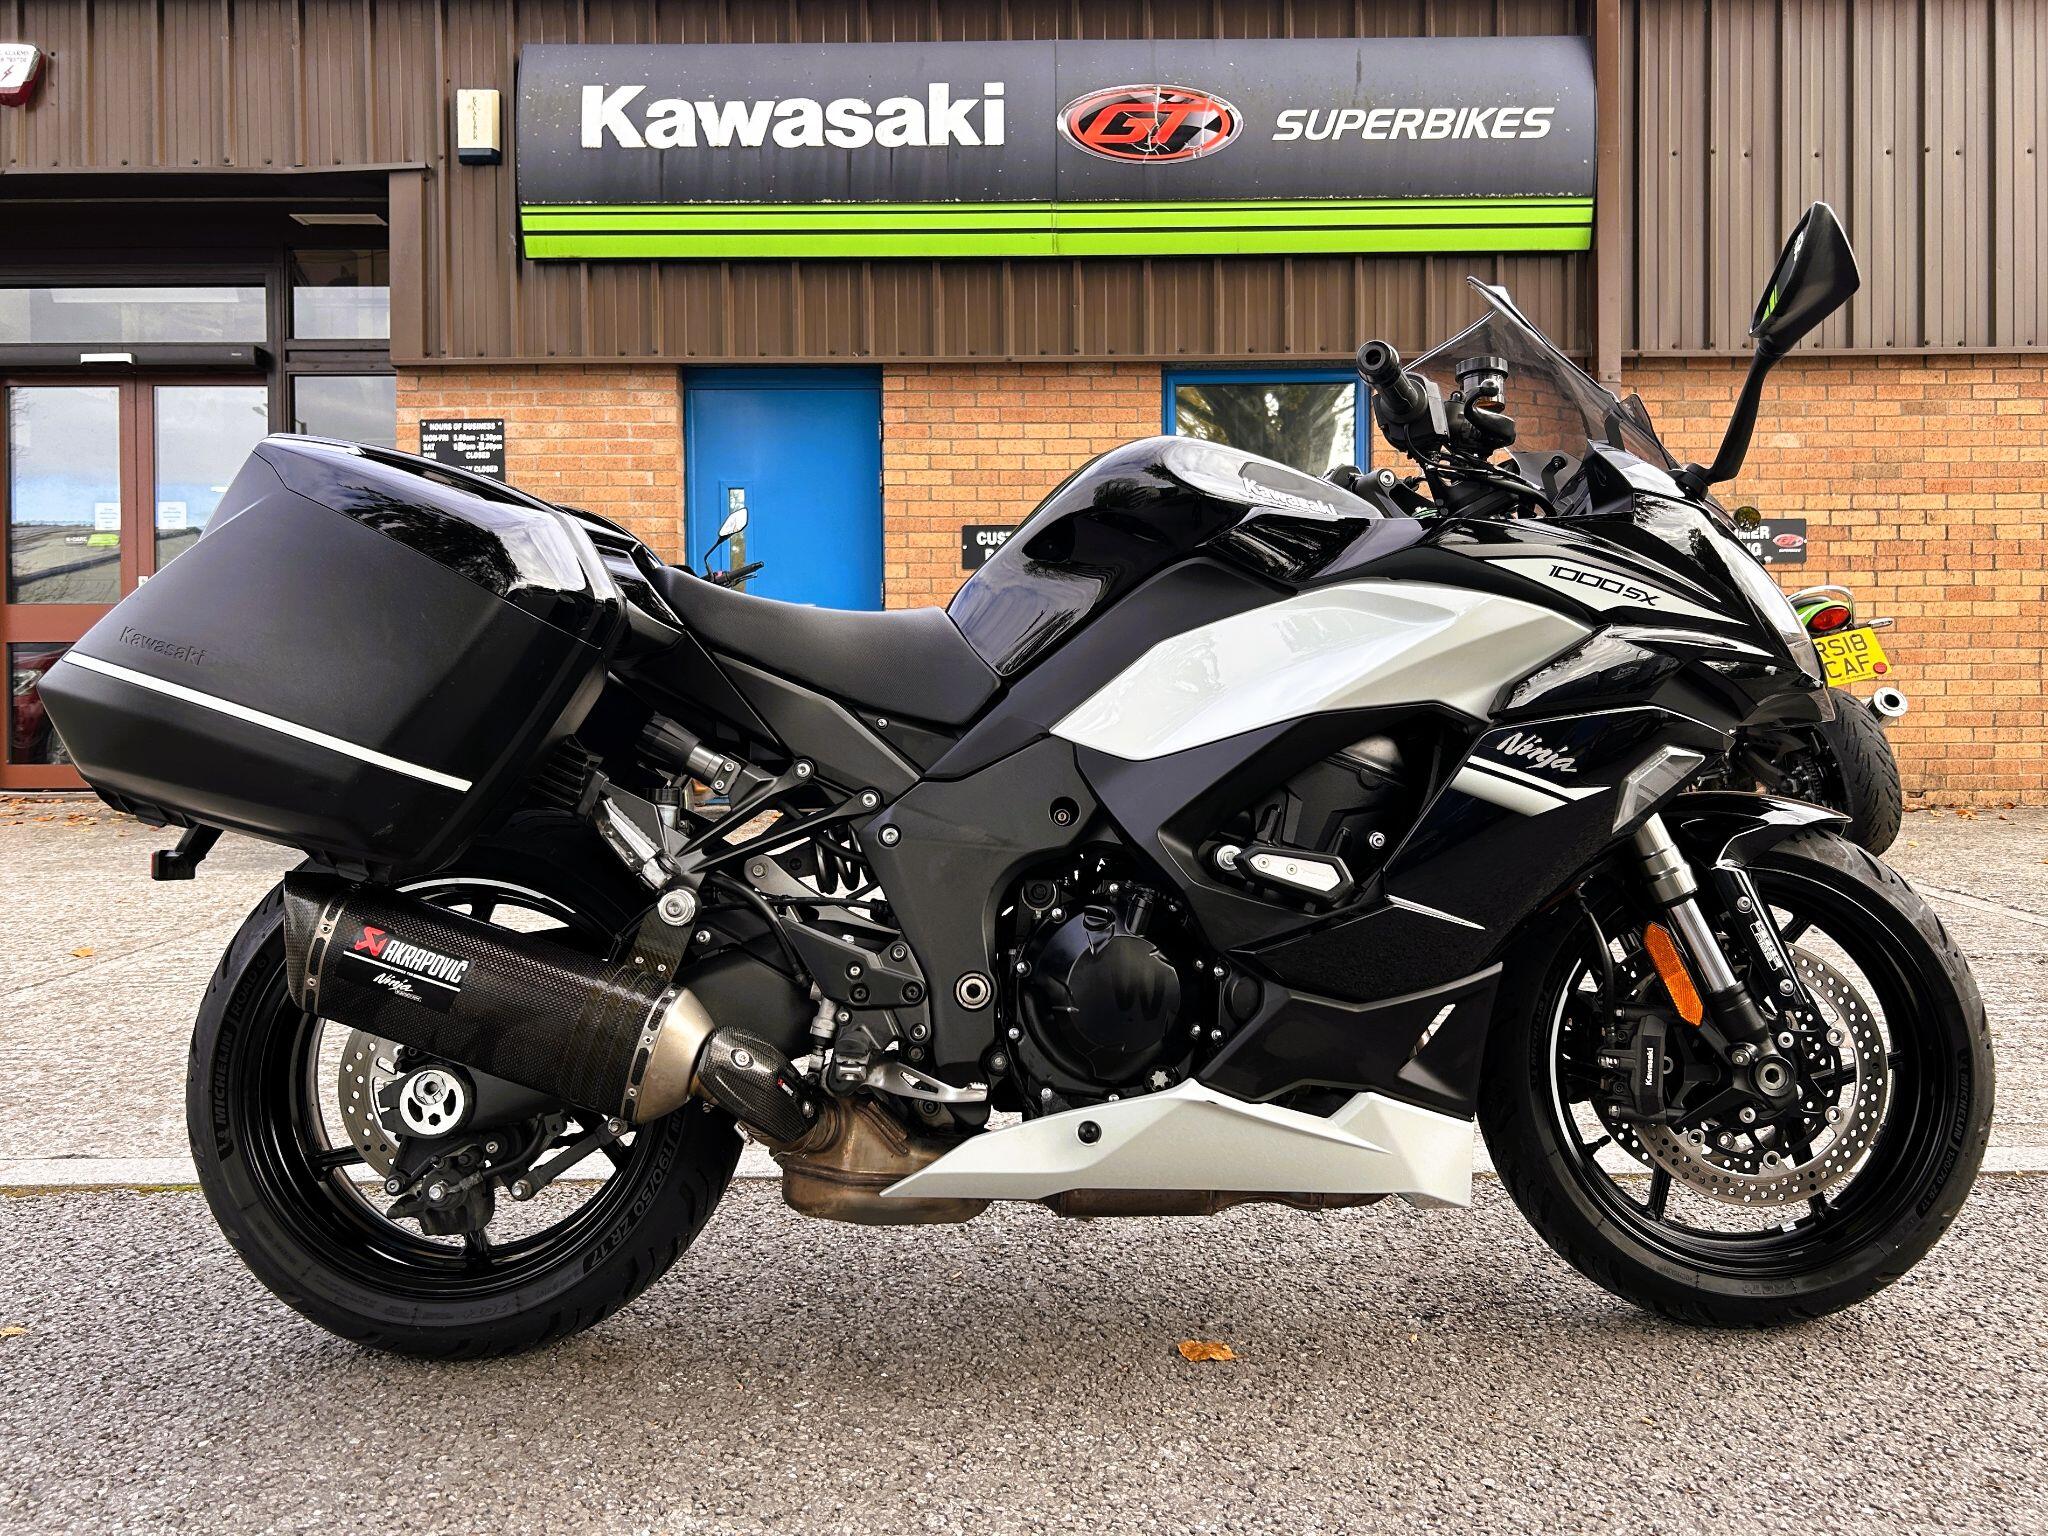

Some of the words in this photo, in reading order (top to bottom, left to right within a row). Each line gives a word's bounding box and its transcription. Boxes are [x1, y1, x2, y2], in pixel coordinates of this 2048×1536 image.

[581, 82, 1005, 150] Kawasaki
[1272, 106, 1555, 141] SUPERBIKES
[429, 422, 453, 431] HOURS
[453, 422, 462, 431] OF
[462, 422, 496, 431] BUSINESS
[422, 443, 436, 451] SAT
[465, 451, 491, 460] CLOSED
[473, 465, 499, 473] CLOSED
[1242, 477, 1338, 516] Kawasaki
[119, 626, 207, 666] Kawasaki
[1815, 633, 1868, 658] RS18
[1824, 652, 1870, 678] CAF
[1496, 732, 1577, 773] Ninja
[373, 972, 414, 992] Ninja
[214, 1030, 234, 1125] MICHELIN
[231, 968, 257, 1017] ROAD
[1645, 1047, 1654, 1086] Kawasaki
[1954, 1074, 1970, 1141] MICHELIN
[634, 1141, 677, 1217] 190/50
[611, 1218, 633, 1247] ZR
[590, 1246, 611, 1268] 17
